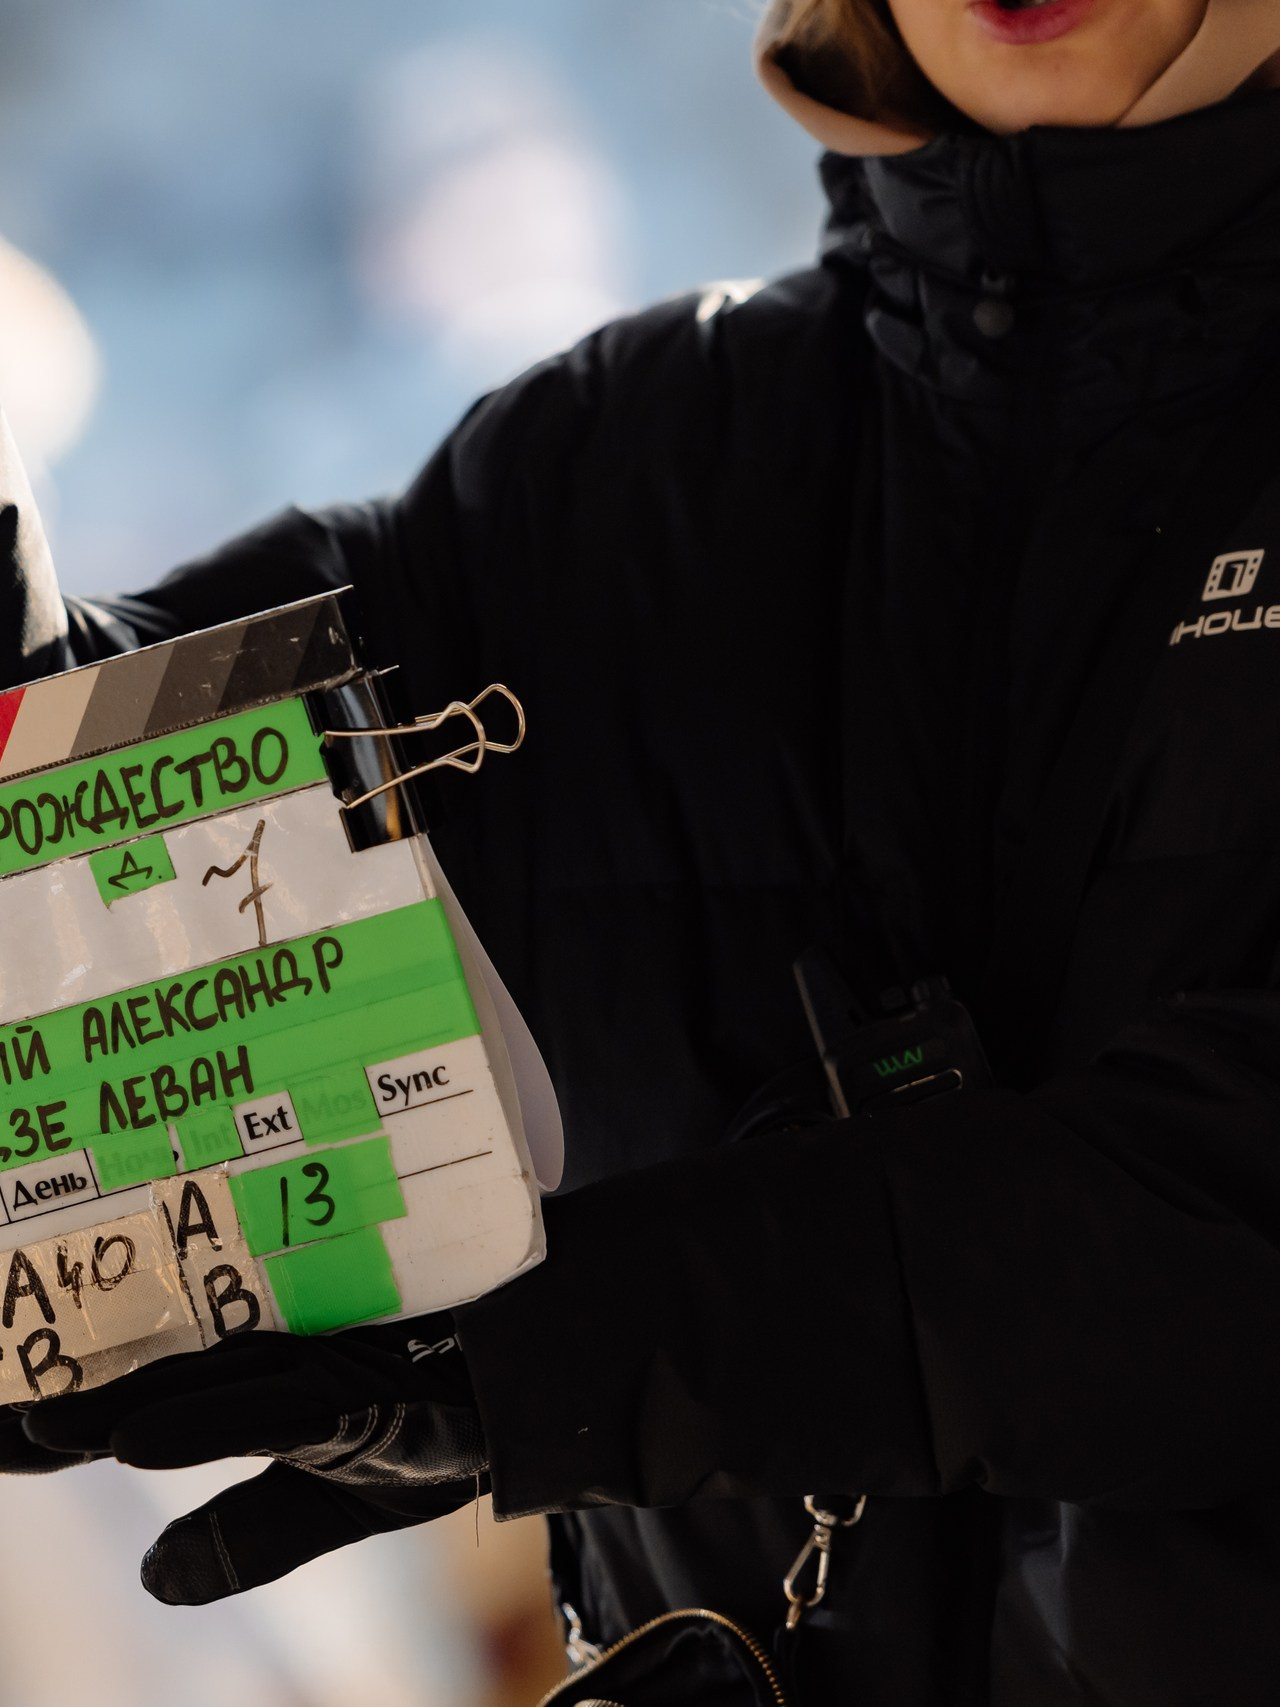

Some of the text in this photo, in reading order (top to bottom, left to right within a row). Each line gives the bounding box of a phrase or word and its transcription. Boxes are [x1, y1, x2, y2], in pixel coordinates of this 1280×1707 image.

[82, 936, 344, 1062] АЛЕКСАНДР
[99, 1044, 255, 1135] ЛЕВАН
[377, 1065, 450, 1107] Sync
[243, 1105, 293, 1140] Ext
[12, 1172, 88, 1212] День
[280, 1162, 335, 1247] 13
